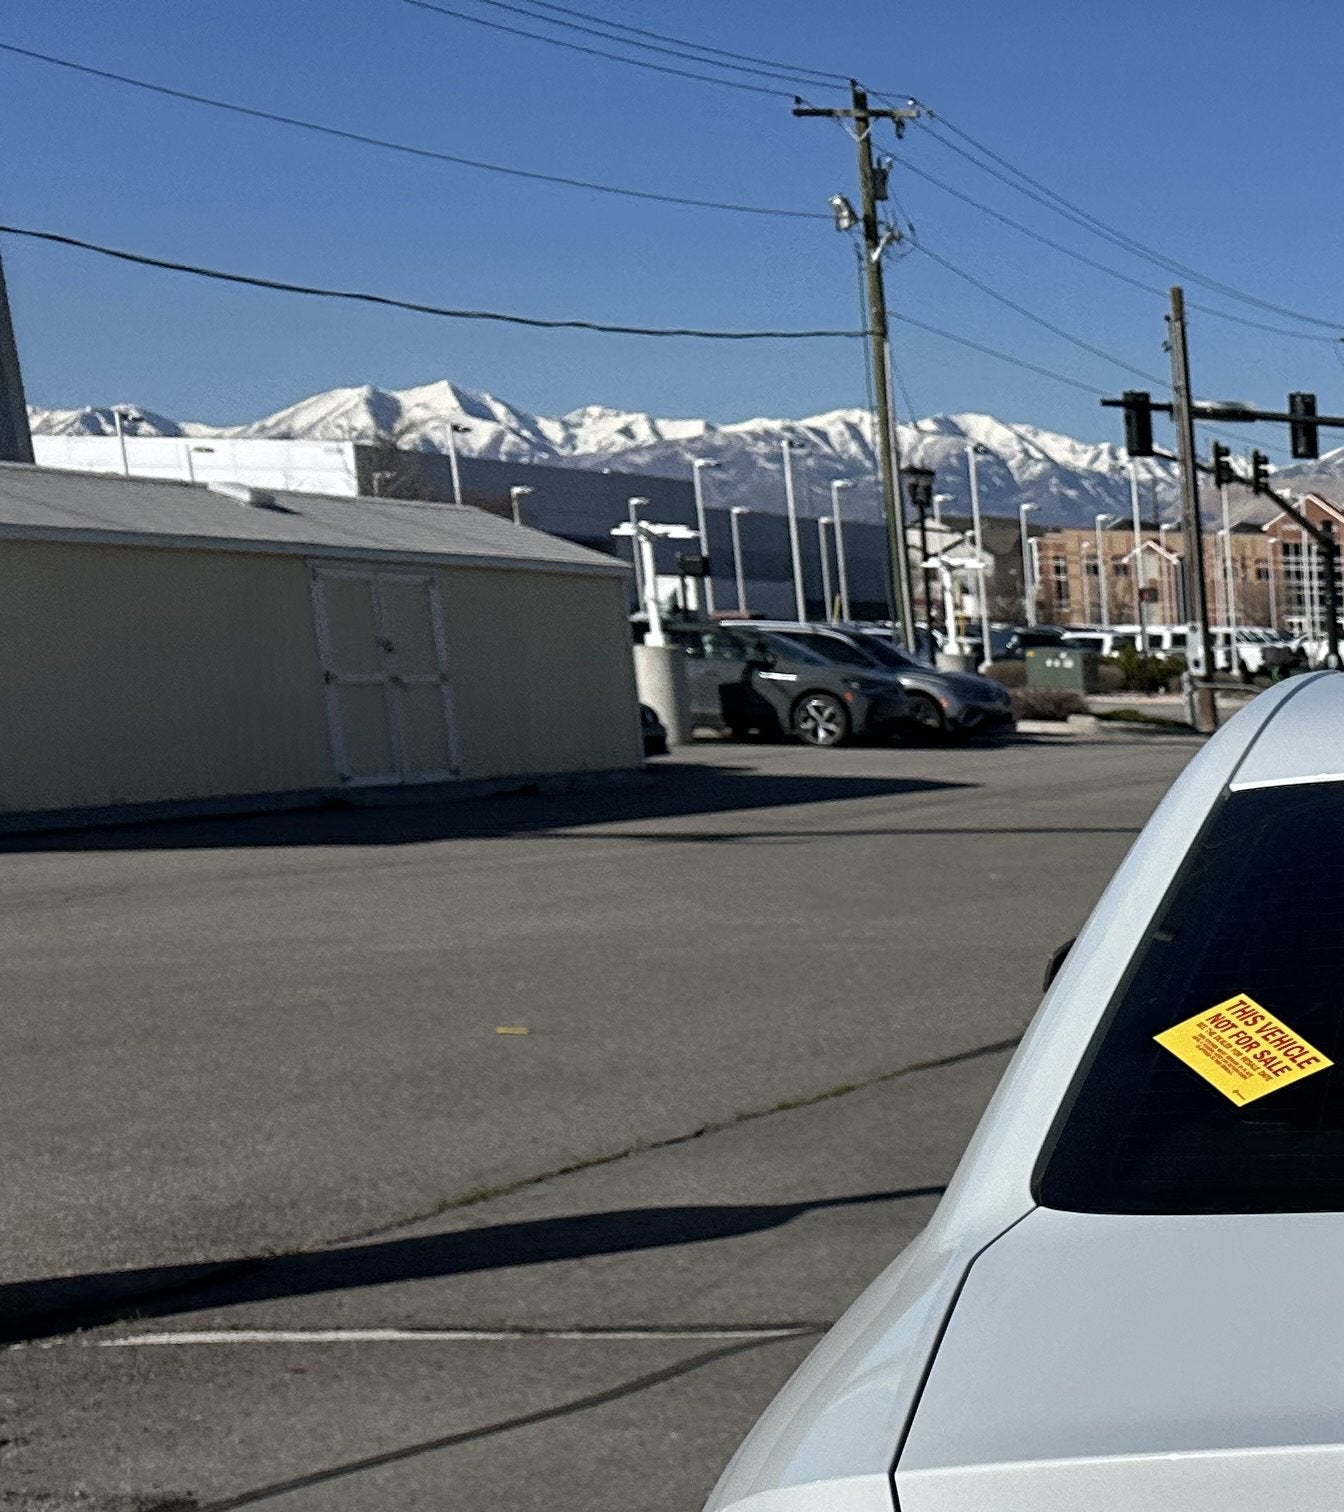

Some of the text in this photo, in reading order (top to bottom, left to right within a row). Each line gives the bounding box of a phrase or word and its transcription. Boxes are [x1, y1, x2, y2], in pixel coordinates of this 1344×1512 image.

[1205, 1012, 1239, 1033] NOT
[1227, 1030, 1261, 1053] FOR
[1252, 1049, 1293, 1077] SALE
[1225, 999, 1265, 1027] THIS
[1254, 1021, 1321, 1070] VEHICLE
